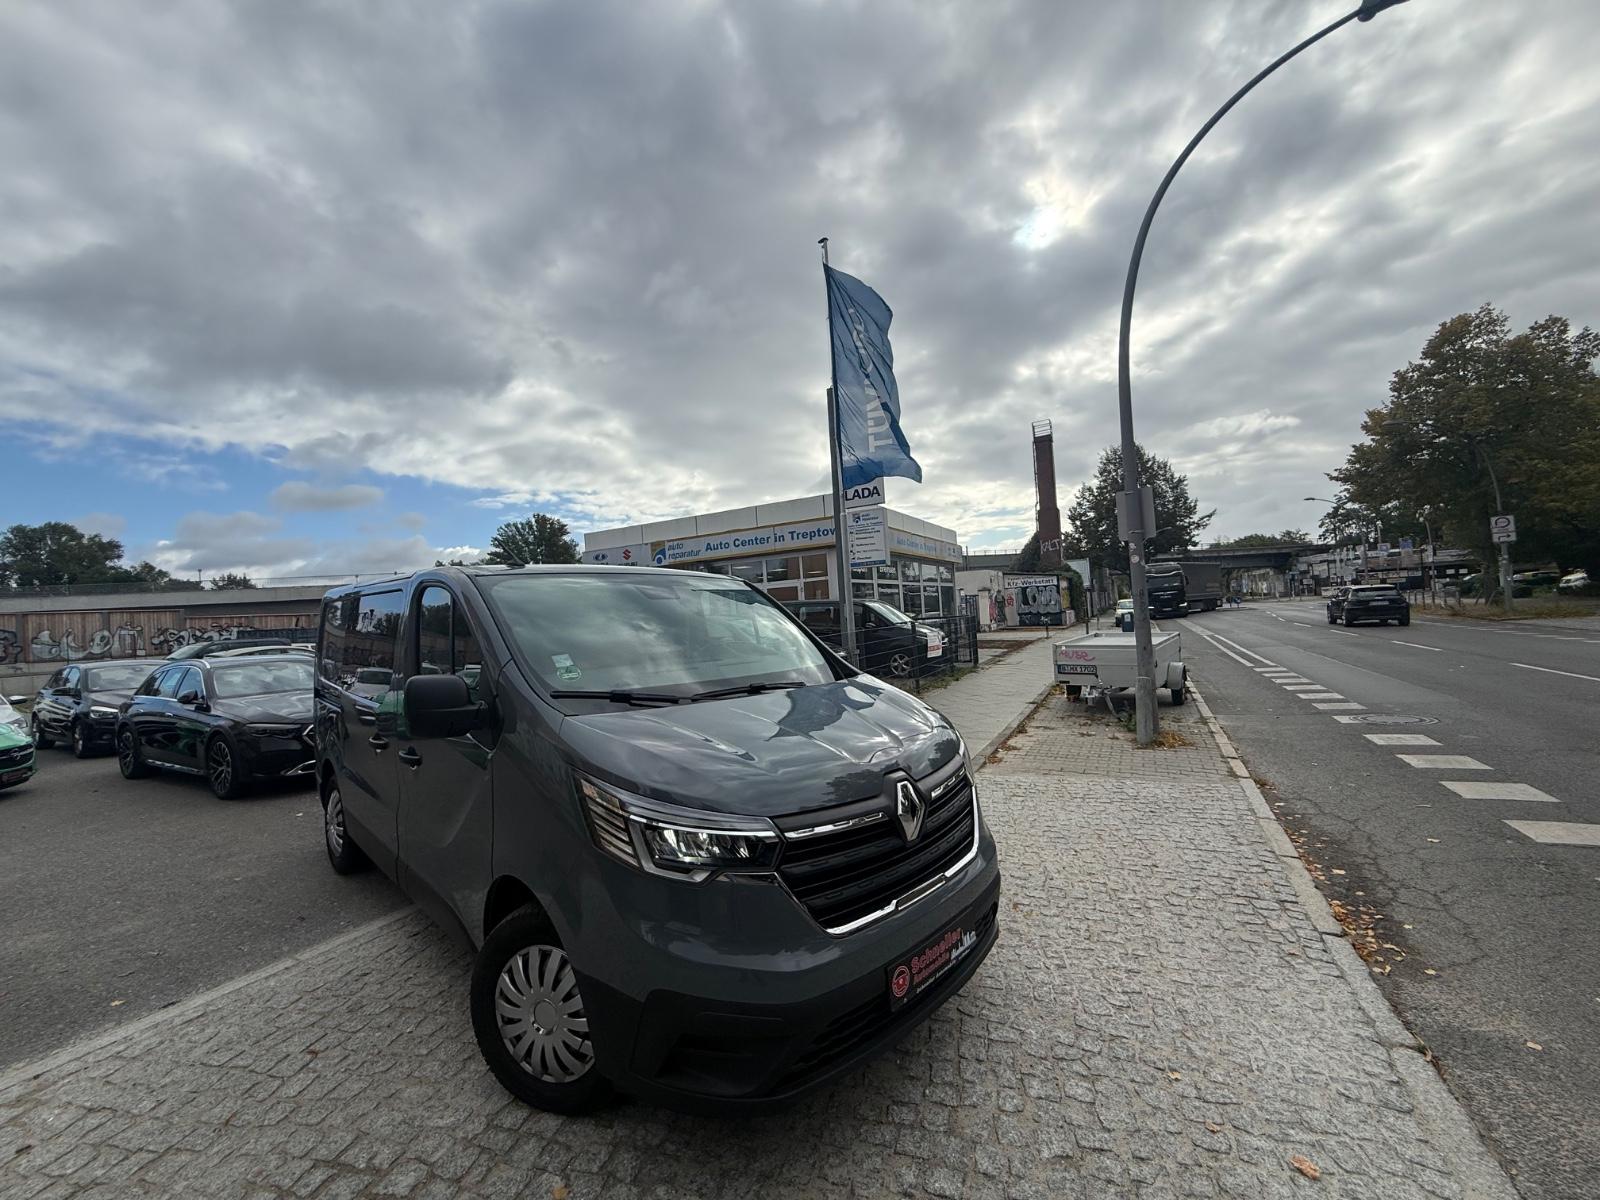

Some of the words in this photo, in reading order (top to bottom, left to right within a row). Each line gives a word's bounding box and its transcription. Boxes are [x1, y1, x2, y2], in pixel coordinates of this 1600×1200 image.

[845, 486, 881, 501] LADA
[667, 542, 684, 552] auto
[705, 541, 730, 552] Auto
[733, 535, 771, 548] Center
[774, 532, 785, 543] in
[668, 549, 702, 561] reparatur
[1007, 578, 1054, 587] Kfz-Werkstatt
